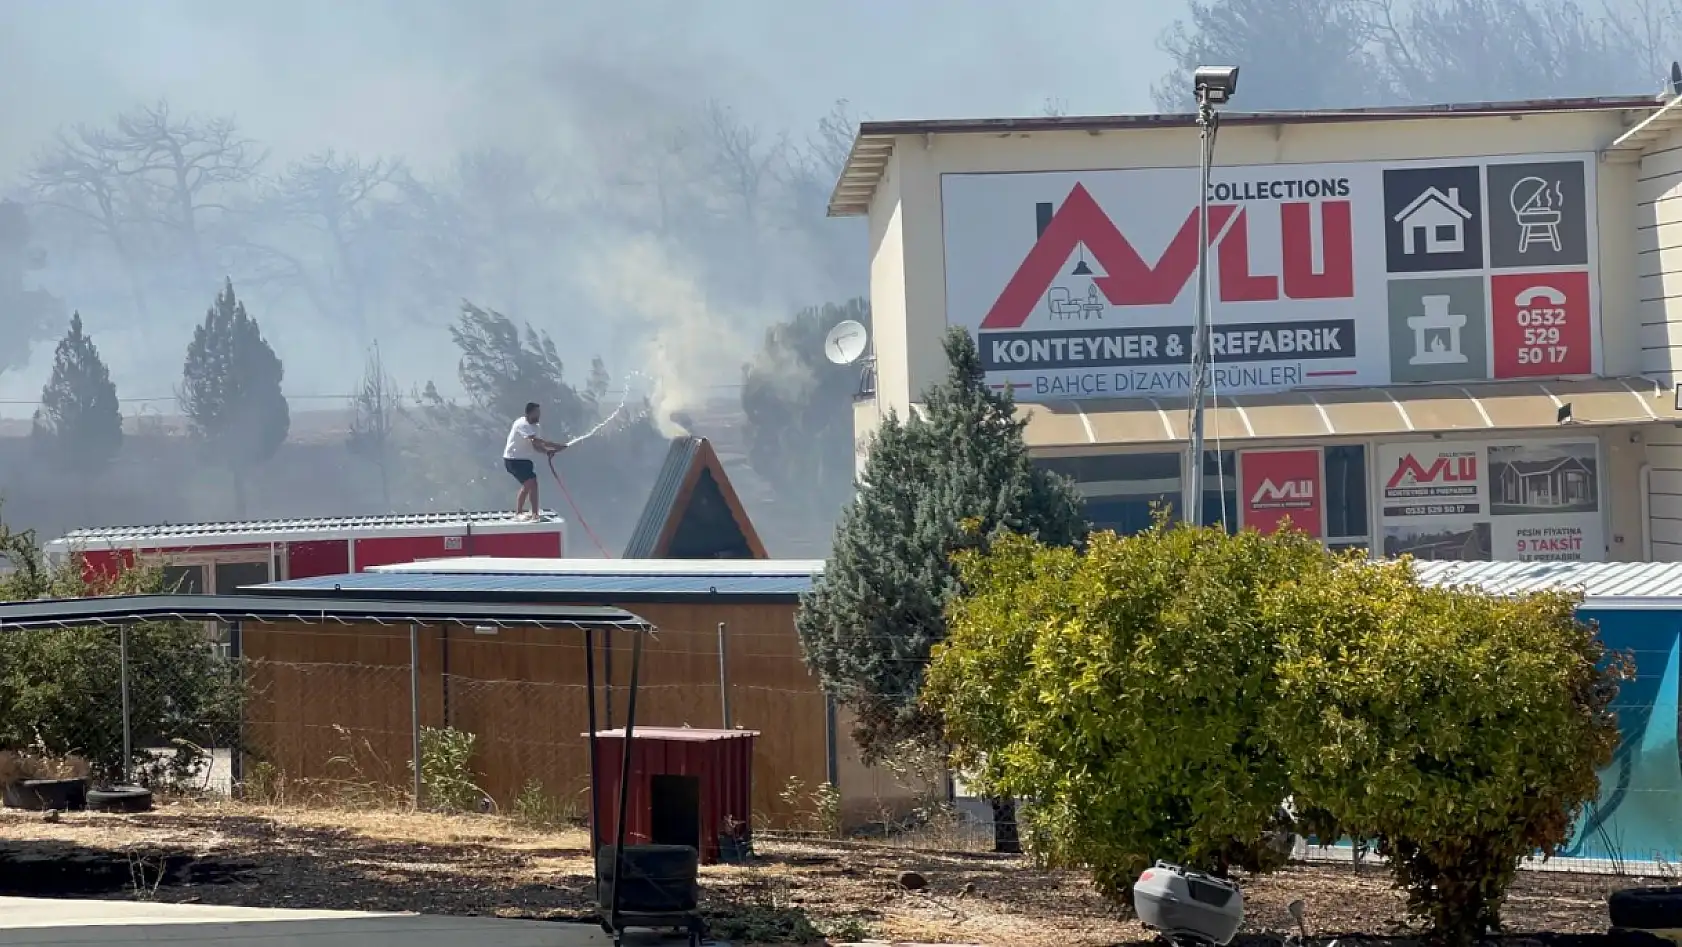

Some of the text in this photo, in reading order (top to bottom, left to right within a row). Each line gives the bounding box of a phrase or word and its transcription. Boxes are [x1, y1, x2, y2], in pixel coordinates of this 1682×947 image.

[1205, 178, 1350, 201] COLLECTIONS
[979, 181, 1354, 328] AVLU
[1517, 309, 1566, 327] 0532
[992, 327, 1342, 364] KONTEYNER & REFABRiK
[1524, 328, 1560, 345] 529
[1518, 346, 1567, 364] 50 17
[1036, 374, 1107, 395] BAHÇE
[1115, 370, 1190, 392] DİZAYN
[1386, 452, 1476, 487] AVLU
[1517, 535, 1582, 552] 9 TAKSİT
